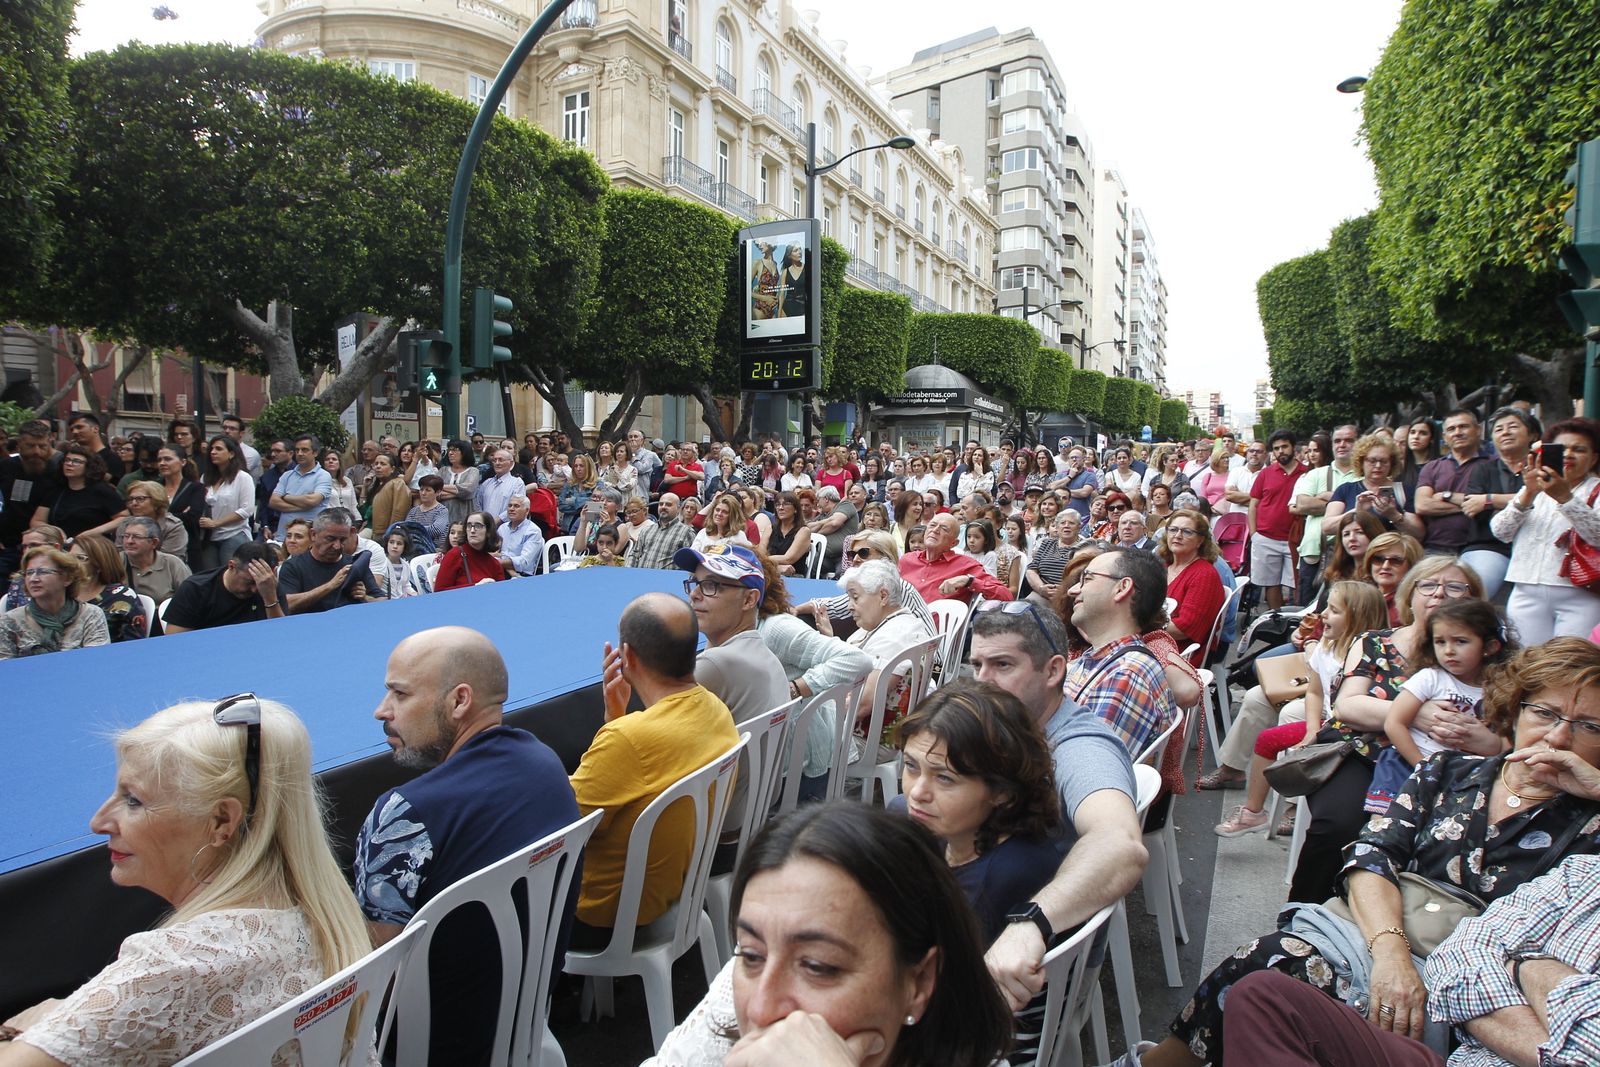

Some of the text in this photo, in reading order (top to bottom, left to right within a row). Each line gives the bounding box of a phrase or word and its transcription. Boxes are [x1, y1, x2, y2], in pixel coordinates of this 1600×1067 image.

[752, 360, 802, 379] 20:12
[467, 416, 474, 432] P
[295, 1010, 315, 1027] 950
[316, 1001, 330, 1014] 29
[332, 992, 343, 1005] 19
